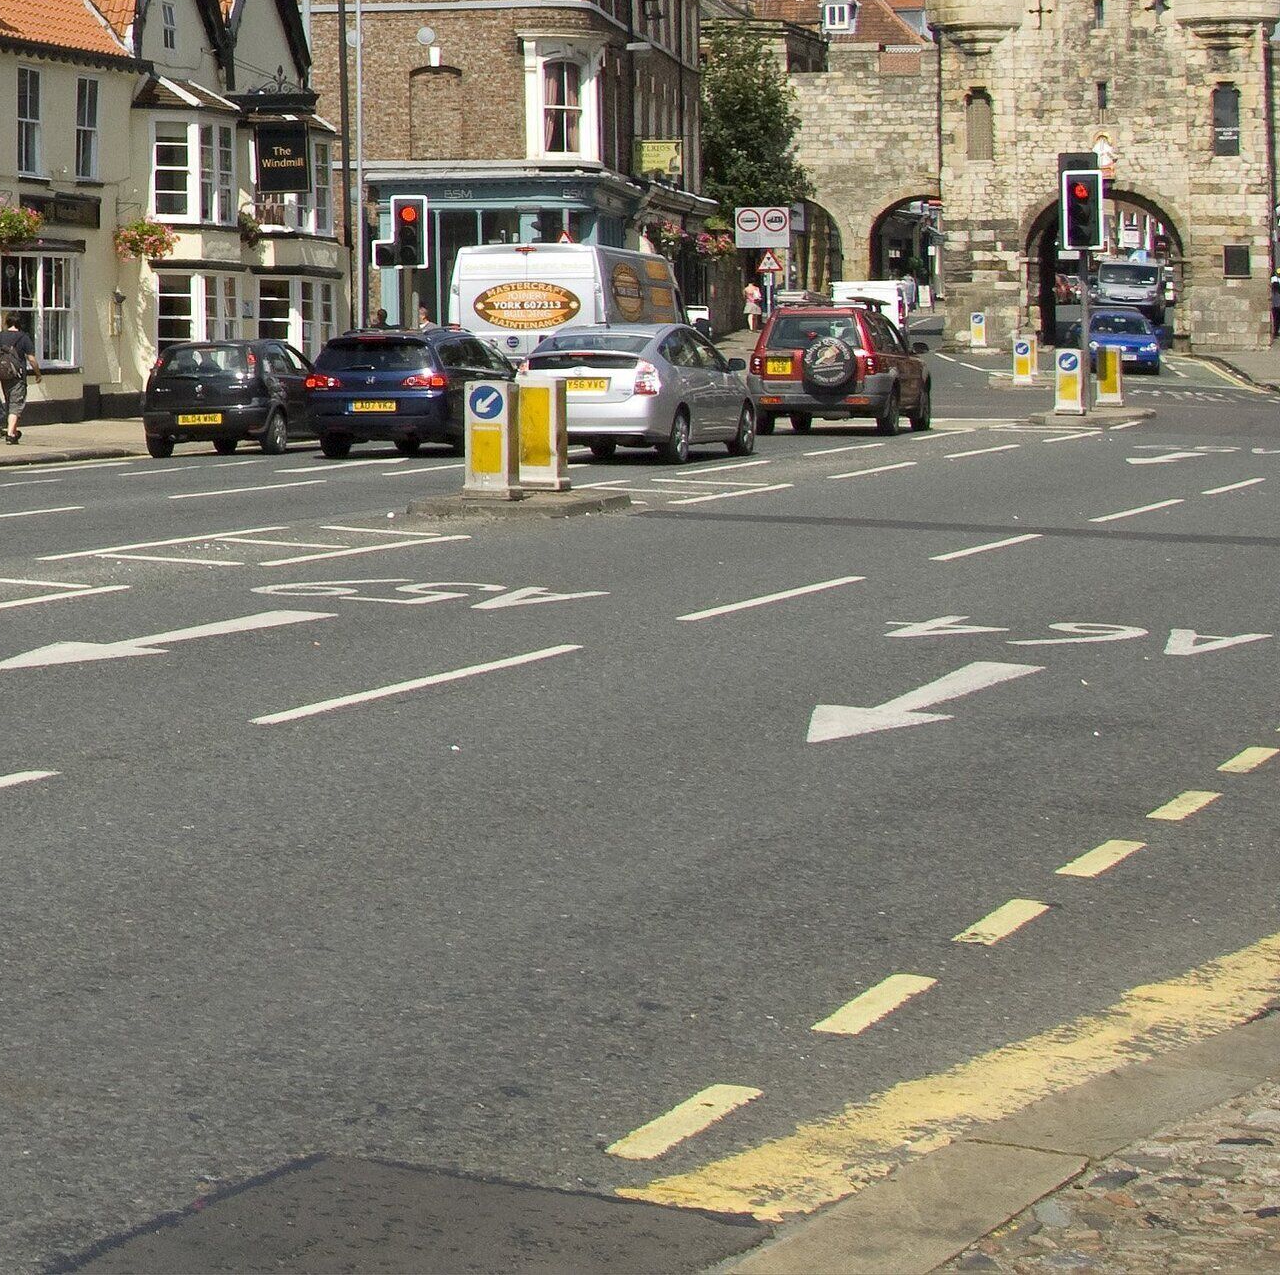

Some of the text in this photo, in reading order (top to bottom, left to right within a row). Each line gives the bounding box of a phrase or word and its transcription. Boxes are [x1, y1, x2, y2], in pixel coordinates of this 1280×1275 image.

[272, 146, 291, 156] The
[262, 157, 304, 167] Windmill
[443, 189, 473, 199] BSM
[485, 282, 567, 298] MASTERCRAFT
[506, 291, 547, 300] JOINERY
[493, 300, 561, 309] YORK 607313
[488, 316, 565, 329] MAINTENANCE
[250, 578, 611, 610] A59
[882, 614, 1274, 656] A64
